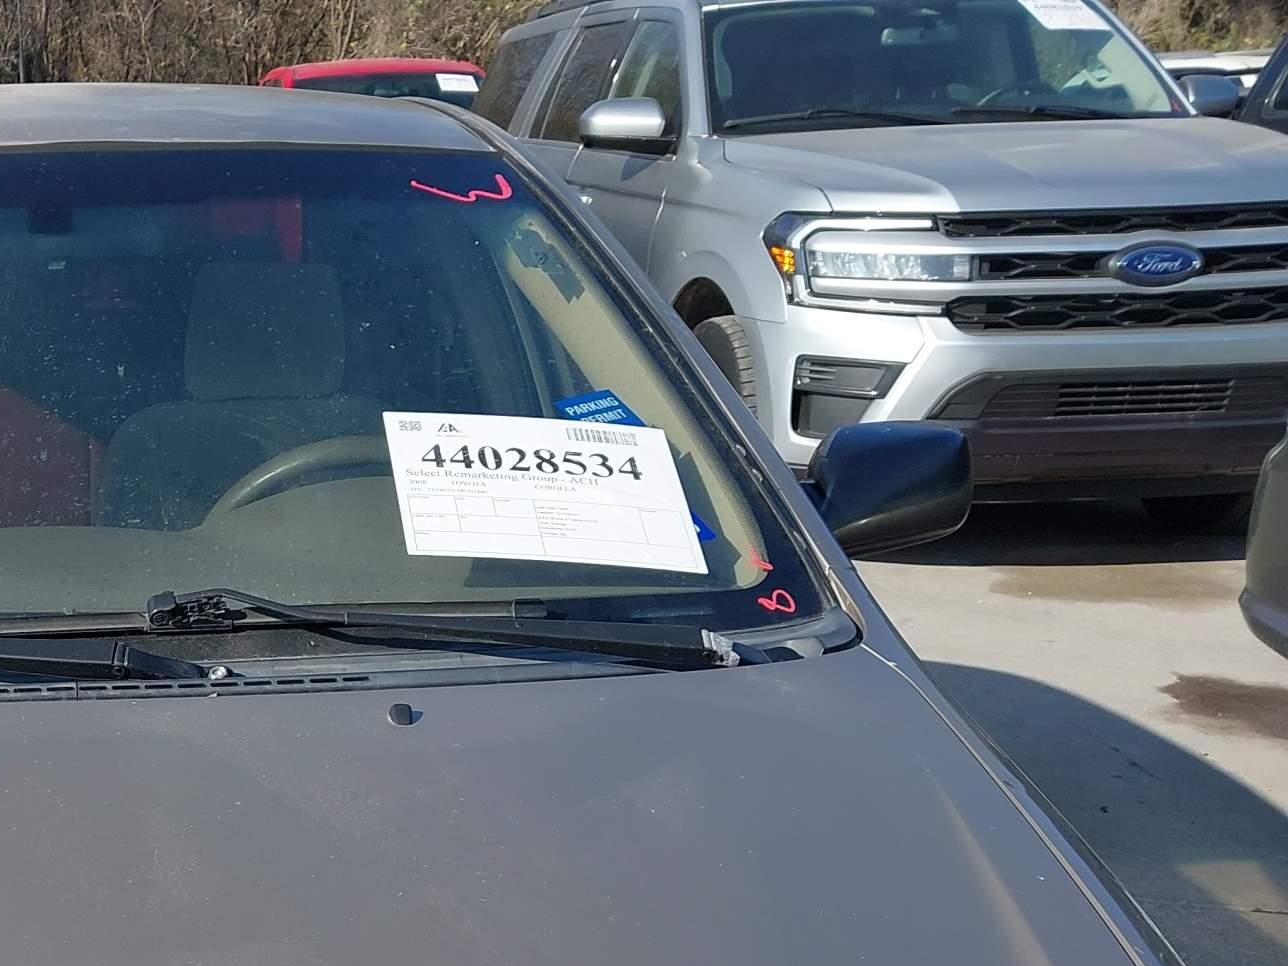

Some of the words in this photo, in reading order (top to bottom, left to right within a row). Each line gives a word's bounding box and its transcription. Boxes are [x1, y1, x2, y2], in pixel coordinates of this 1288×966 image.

[1133, 252, 1185, 273] Ford
[565, 396, 620, 416] PARKING
[421, 443, 644, 481] 44028534
[406, 468, 441, 477] Select
[445, 469, 518, 482] Remarketing
[522, 474, 558, 484] Group
